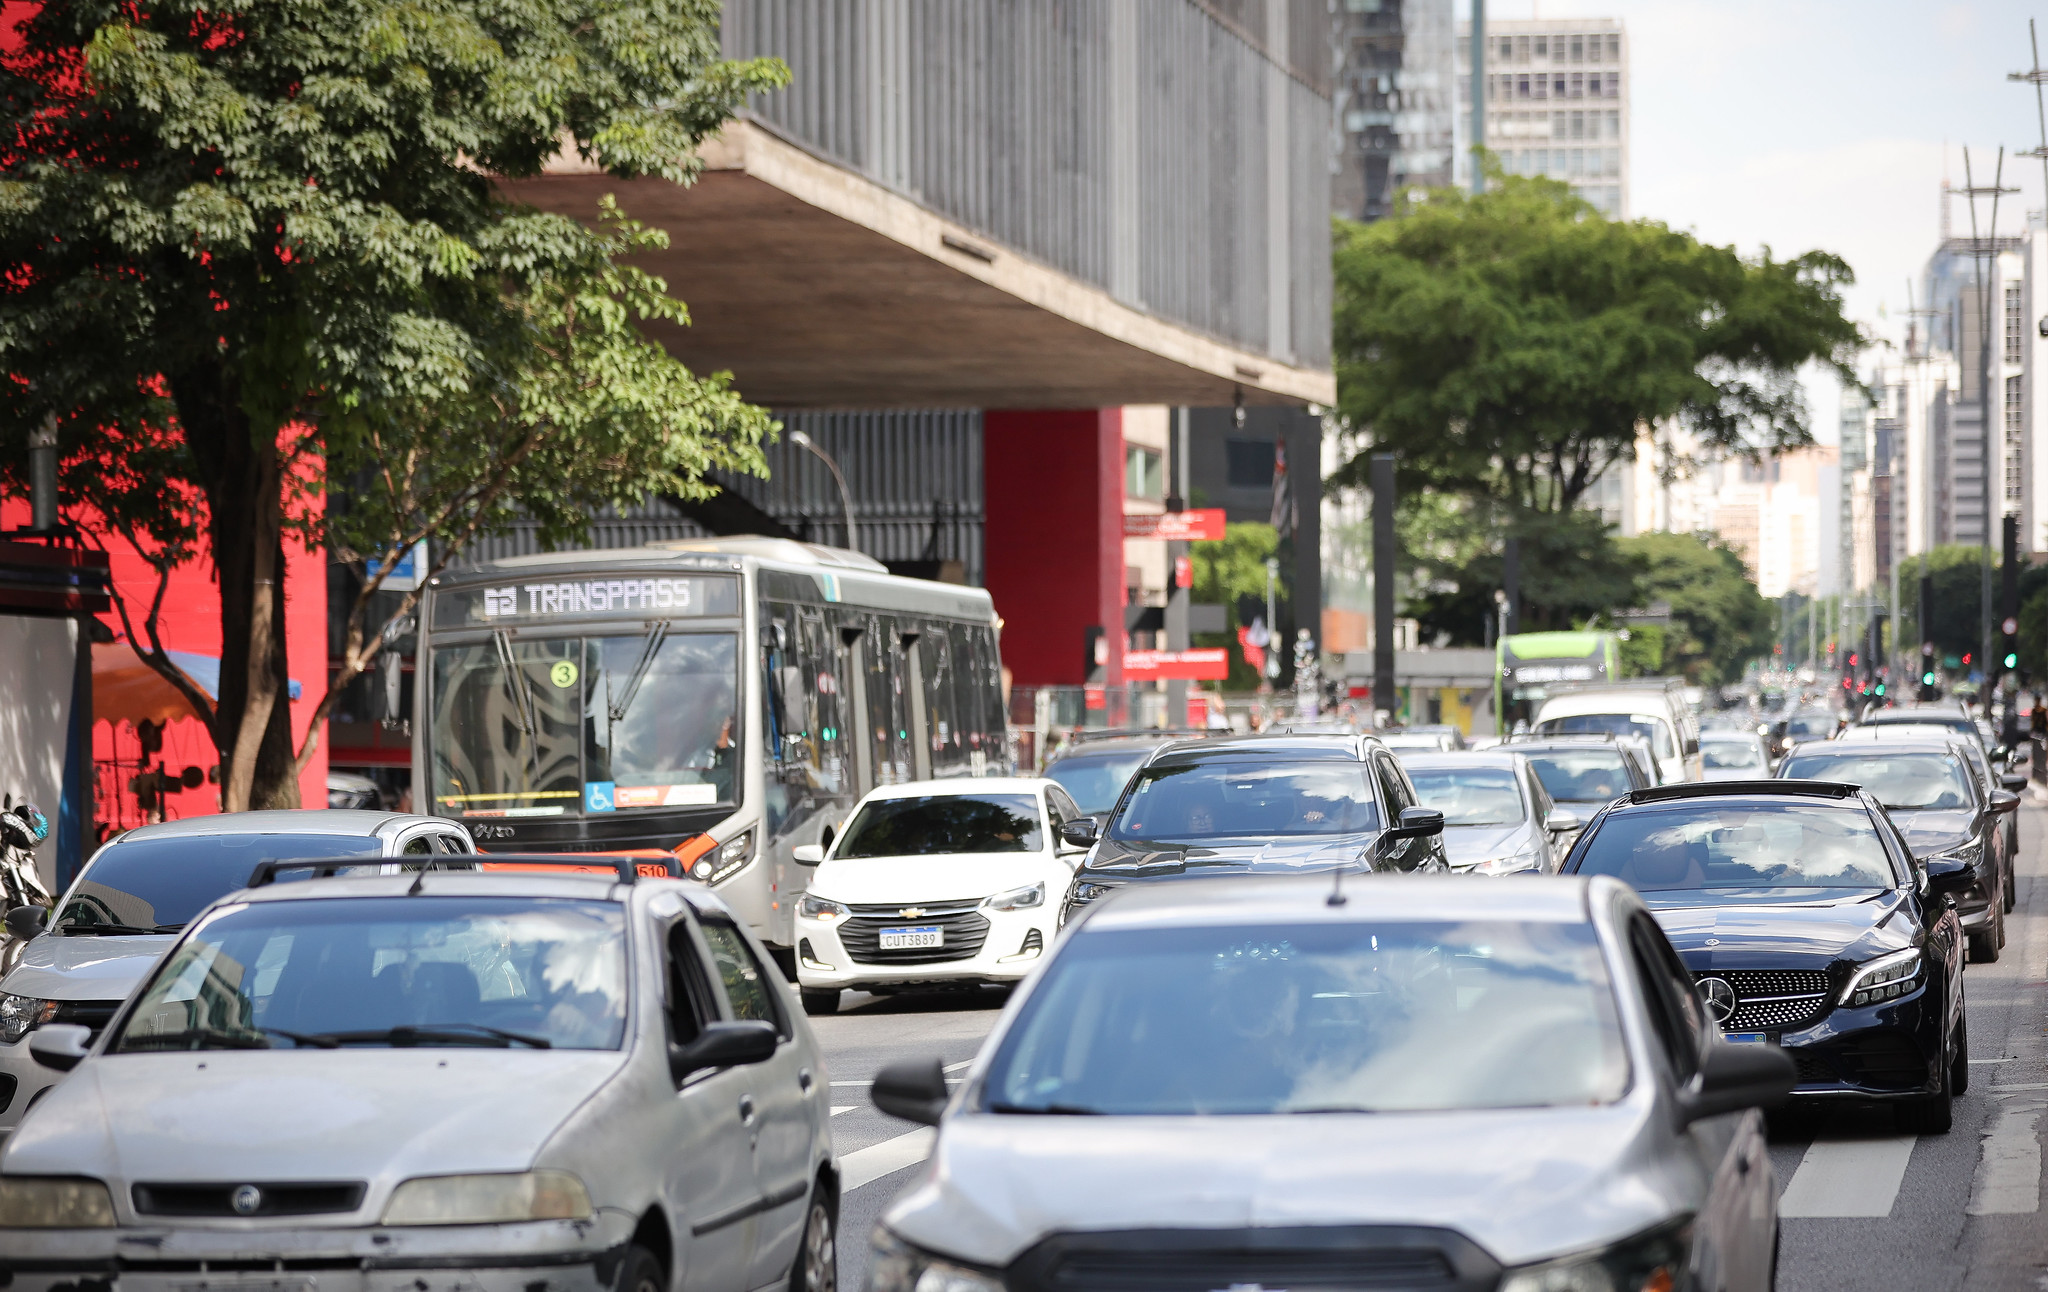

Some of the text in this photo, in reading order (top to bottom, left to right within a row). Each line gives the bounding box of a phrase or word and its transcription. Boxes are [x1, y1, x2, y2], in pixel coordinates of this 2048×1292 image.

[524, 579, 690, 614] TRANSPPASS
[557, 665, 570, 684] 3
[886, 934, 936, 947] CUT3B89
